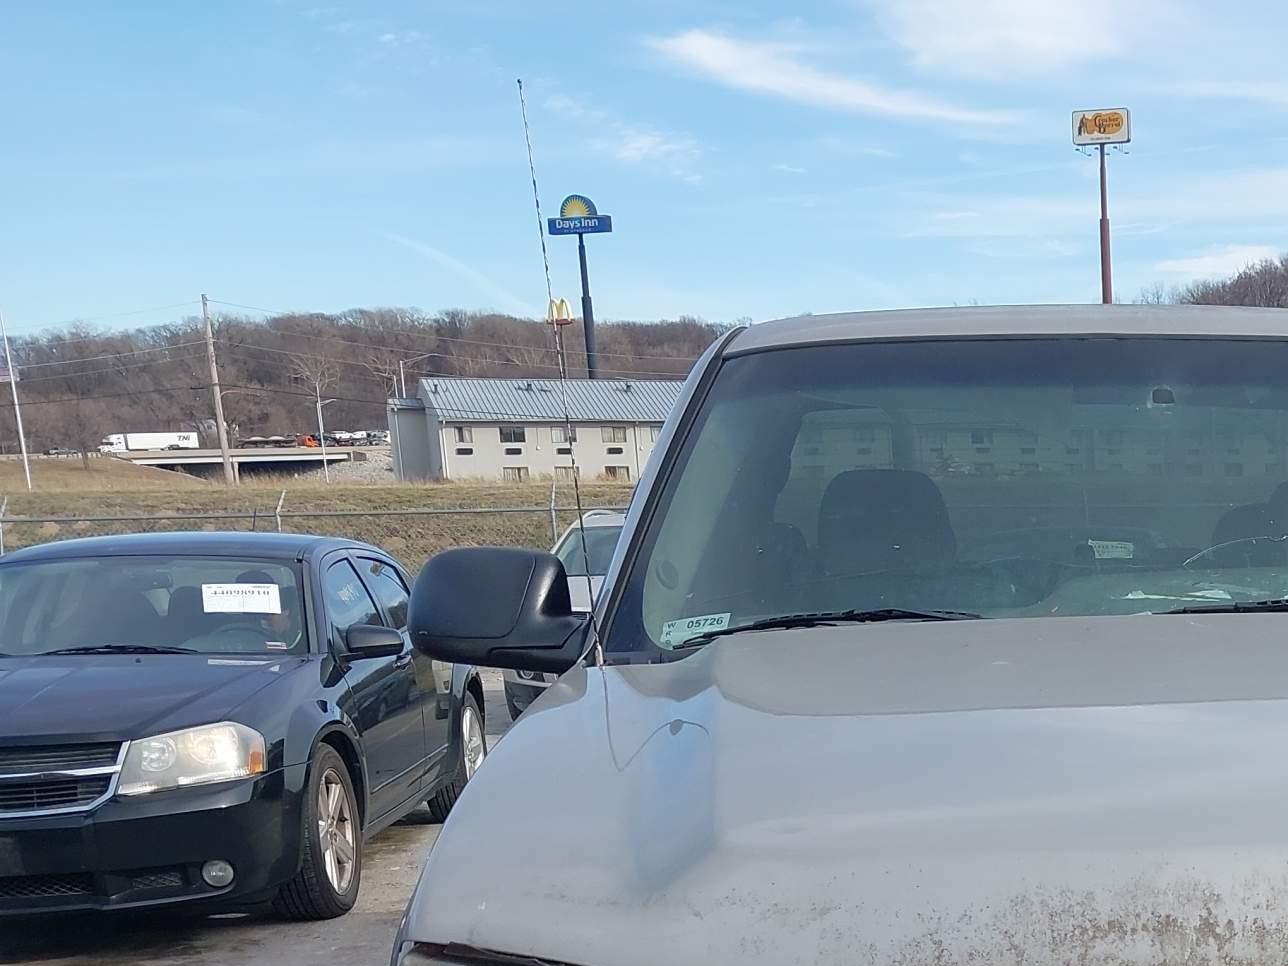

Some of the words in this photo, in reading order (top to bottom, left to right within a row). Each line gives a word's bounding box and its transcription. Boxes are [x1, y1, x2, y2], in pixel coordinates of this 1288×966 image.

[555, 218, 581, 229] Days
[581, 218, 599, 227] Inn
[686, 616, 724, 629] 05726
